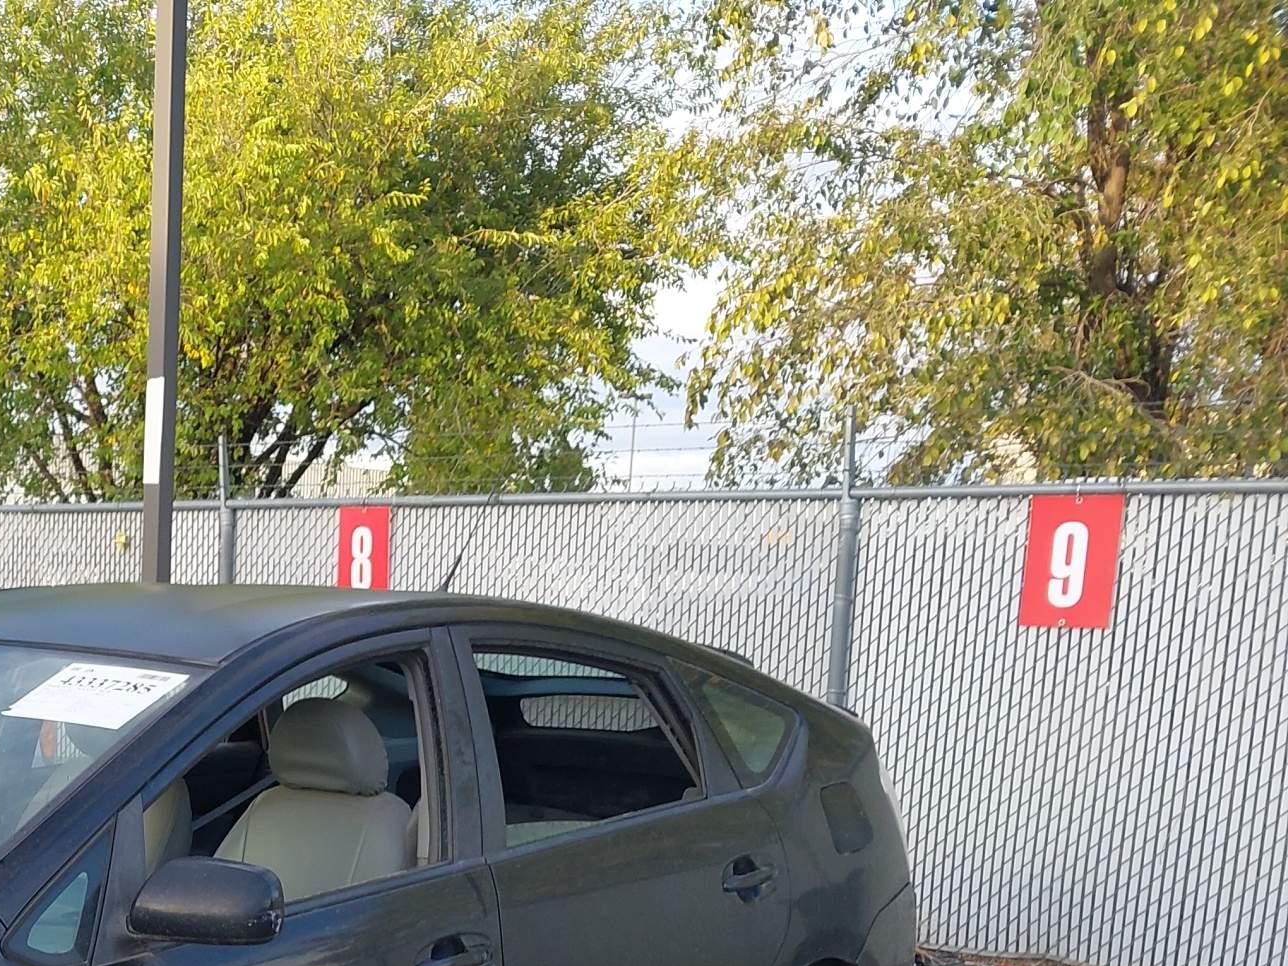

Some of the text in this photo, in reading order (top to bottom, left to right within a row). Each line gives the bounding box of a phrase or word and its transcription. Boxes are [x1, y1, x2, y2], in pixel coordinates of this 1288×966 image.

[350, 525, 373, 590] 8
[1048, 521, 1089, 609] 9
[60, 675, 158, 694] 43337285
